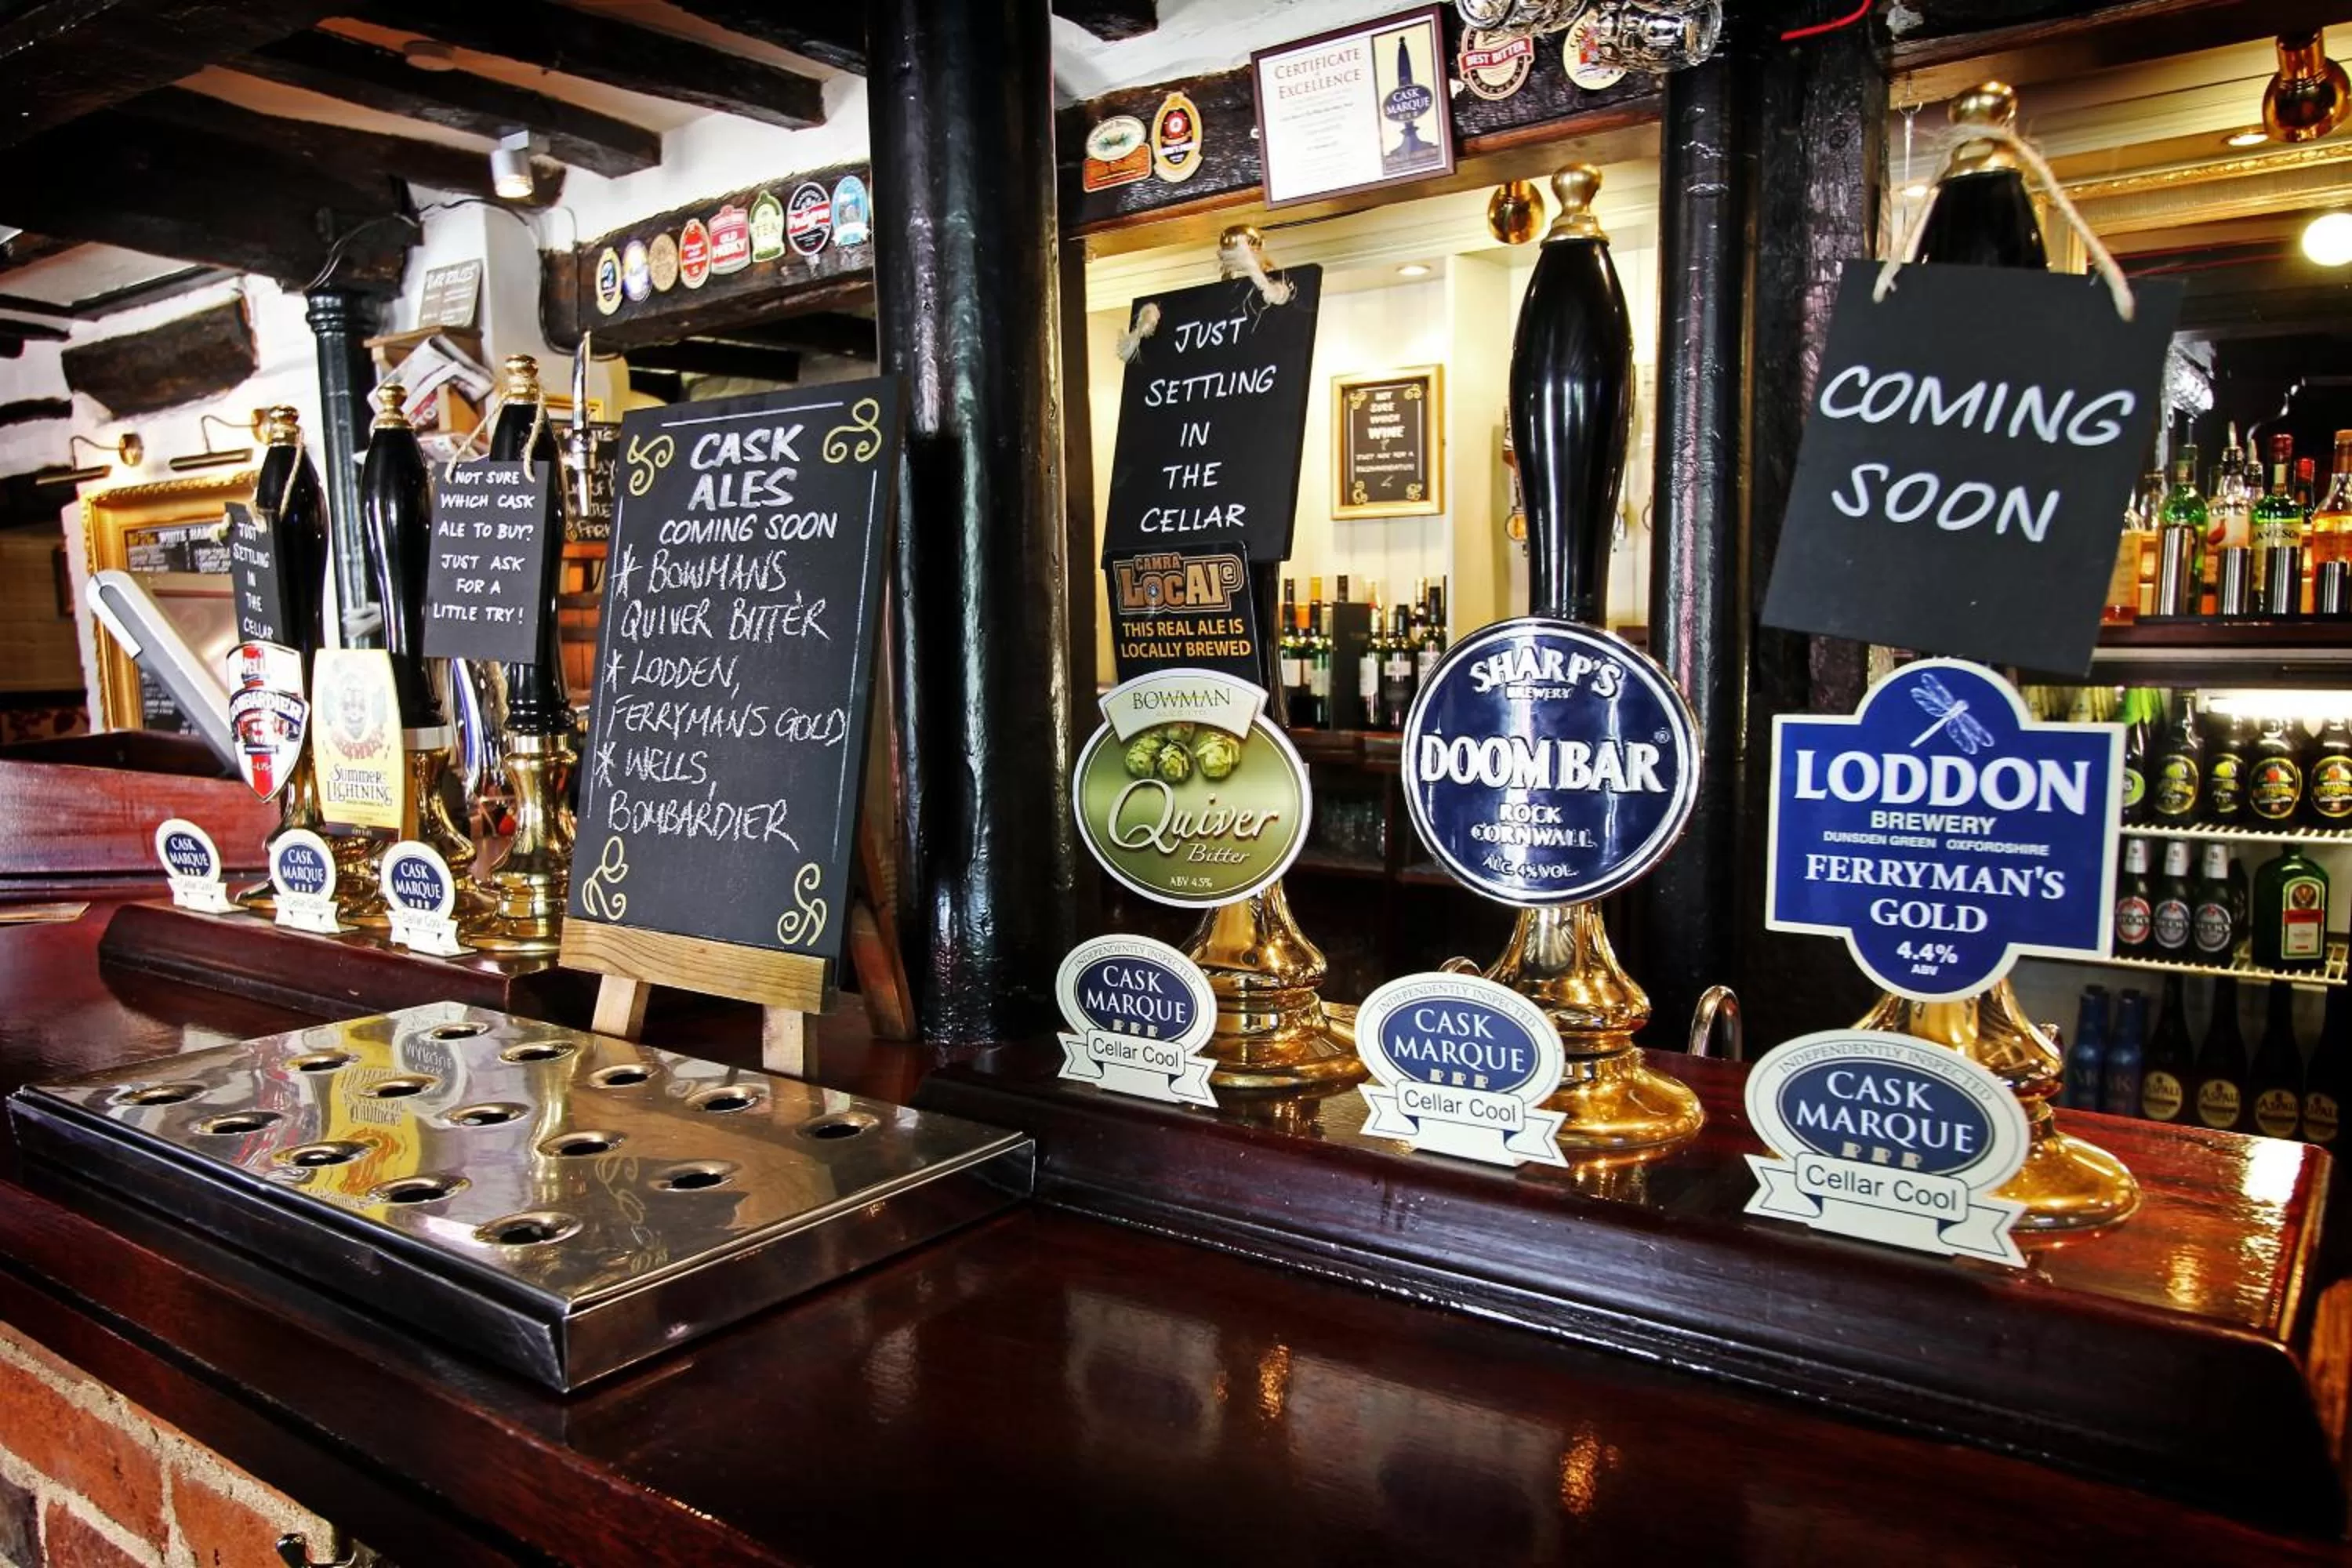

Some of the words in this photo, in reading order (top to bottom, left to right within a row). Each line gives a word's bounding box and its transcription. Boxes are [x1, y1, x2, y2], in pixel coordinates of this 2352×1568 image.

[1274, 48, 1362, 79] CERTIFICATE
[1465, 53, 1490, 67] BEST
[1491, 41, 1527, 63] BITTER
[1278, 68, 1362, 99] EXCELLENCE
[1392, 87, 1420, 101] CASK
[1385, 96, 1431, 115] MARQUE
[1174, 317, 1247, 353] JUST
[1144, 365, 1277, 407] SETTLING
[1820, 365, 2135, 446] COMING
[690, 424, 805, 470] CASK
[1179, 421, 1210, 448] IN
[455, 470, 485, 485] NOT
[487, 471, 520, 485] SURE
[688, 466, 798, 511] ALES
[1163, 462, 1222, 490] THE
[440, 493, 489, 509] WHICH
[497, 494, 535, 510] CASK
[1831, 463, 2060, 543] SOON
[438, 521, 466, 538] ALE
[474, 522, 492, 538] TO
[497, 523, 534, 541] BUY?
[659, 514, 757, 545] COMING
[765, 511, 838, 541] SOON
[1140, 503, 1246, 533] CELLAR
[233, 542, 270, 568] SETTLING
[441, 554, 480, 570] JUST
[490, 556, 525, 572] ASK
[1136, 556, 1180, 570] CAMRA
[456, 578, 485, 593] FOR
[490, 579, 501, 593] A
[245, 592, 263, 612] THE
[433, 602, 477, 620] LITTLE
[243, 617, 274, 641] CELLAR
[621, 597, 714, 642] QUIVER
[728, 596, 831, 644] BITTER
[1123, 621, 1155, 637] THIS
[1157, 620, 1195, 636] REAL
[1198, 619, 1226, 635] ALE
[1229, 618, 1244, 634] IS
[1121, 641, 1183, 659] LOCALLY
[1185, 640, 1251, 657] BREWED
[1468, 645, 1622, 698] SHARP'S
[1132, 688, 1232, 710] BOWMAN
[1506, 685, 1573, 699] BREWERY
[775, 707, 847, 747] GOLD
[1794, 749, 2090, 815] LODDON
[1108, 779, 1279, 855] Quiver
[1499, 804, 1563, 823] ROCK
[1870, 811, 1997, 835] BREWERY
[170, 837, 197, 851] CASK
[1470, 822, 1599, 848] CORNWALL
[1823, 830, 1886, 845] DUNSDEN
[1889, 835, 1937, 849] GREEN
[1945, 838, 2050, 856] OXFORDSHIRE
[169, 851, 209, 867] MARQUE
[288, 849, 314, 865] CASK
[1186, 843, 1250, 864] Bitter
[282, 865, 324, 884] MARQUE
[401, 862, 429, 880] CASK
[1170, 876, 1189, 887] ABV
[1805, 853, 2066, 900] FERRYMAN'S
[395, 879, 441, 898] MARQUE
[1870, 898, 1988, 933] GOLD
[1896, 940, 1958, 964] 4.4%
[1102, 965, 1164, 994] CASK
[1910, 963, 1940, 977] ABV
[1086, 987, 1187, 1024] MARQUE
[1415, 1008, 1496, 1040] CASK
[1092, 1037, 1137, 1059] Cellar
[1142, 1046, 1179, 1068] Cool
[1394, 1034, 1525, 1073] MARQUE
[1777, 1043, 1902, 1074] INDEPENDENTLY
[1826, 1070, 1935, 1112] CASK
[1404, 1089, 1463, 1115] Cellar
[1469, 1098, 1516, 1123] Cool
[1796, 1100, 1975, 1154] MARQUE
[1806, 1163, 1885, 1196] Cellar
[1893, 1180, 1957, 1211] Cool
